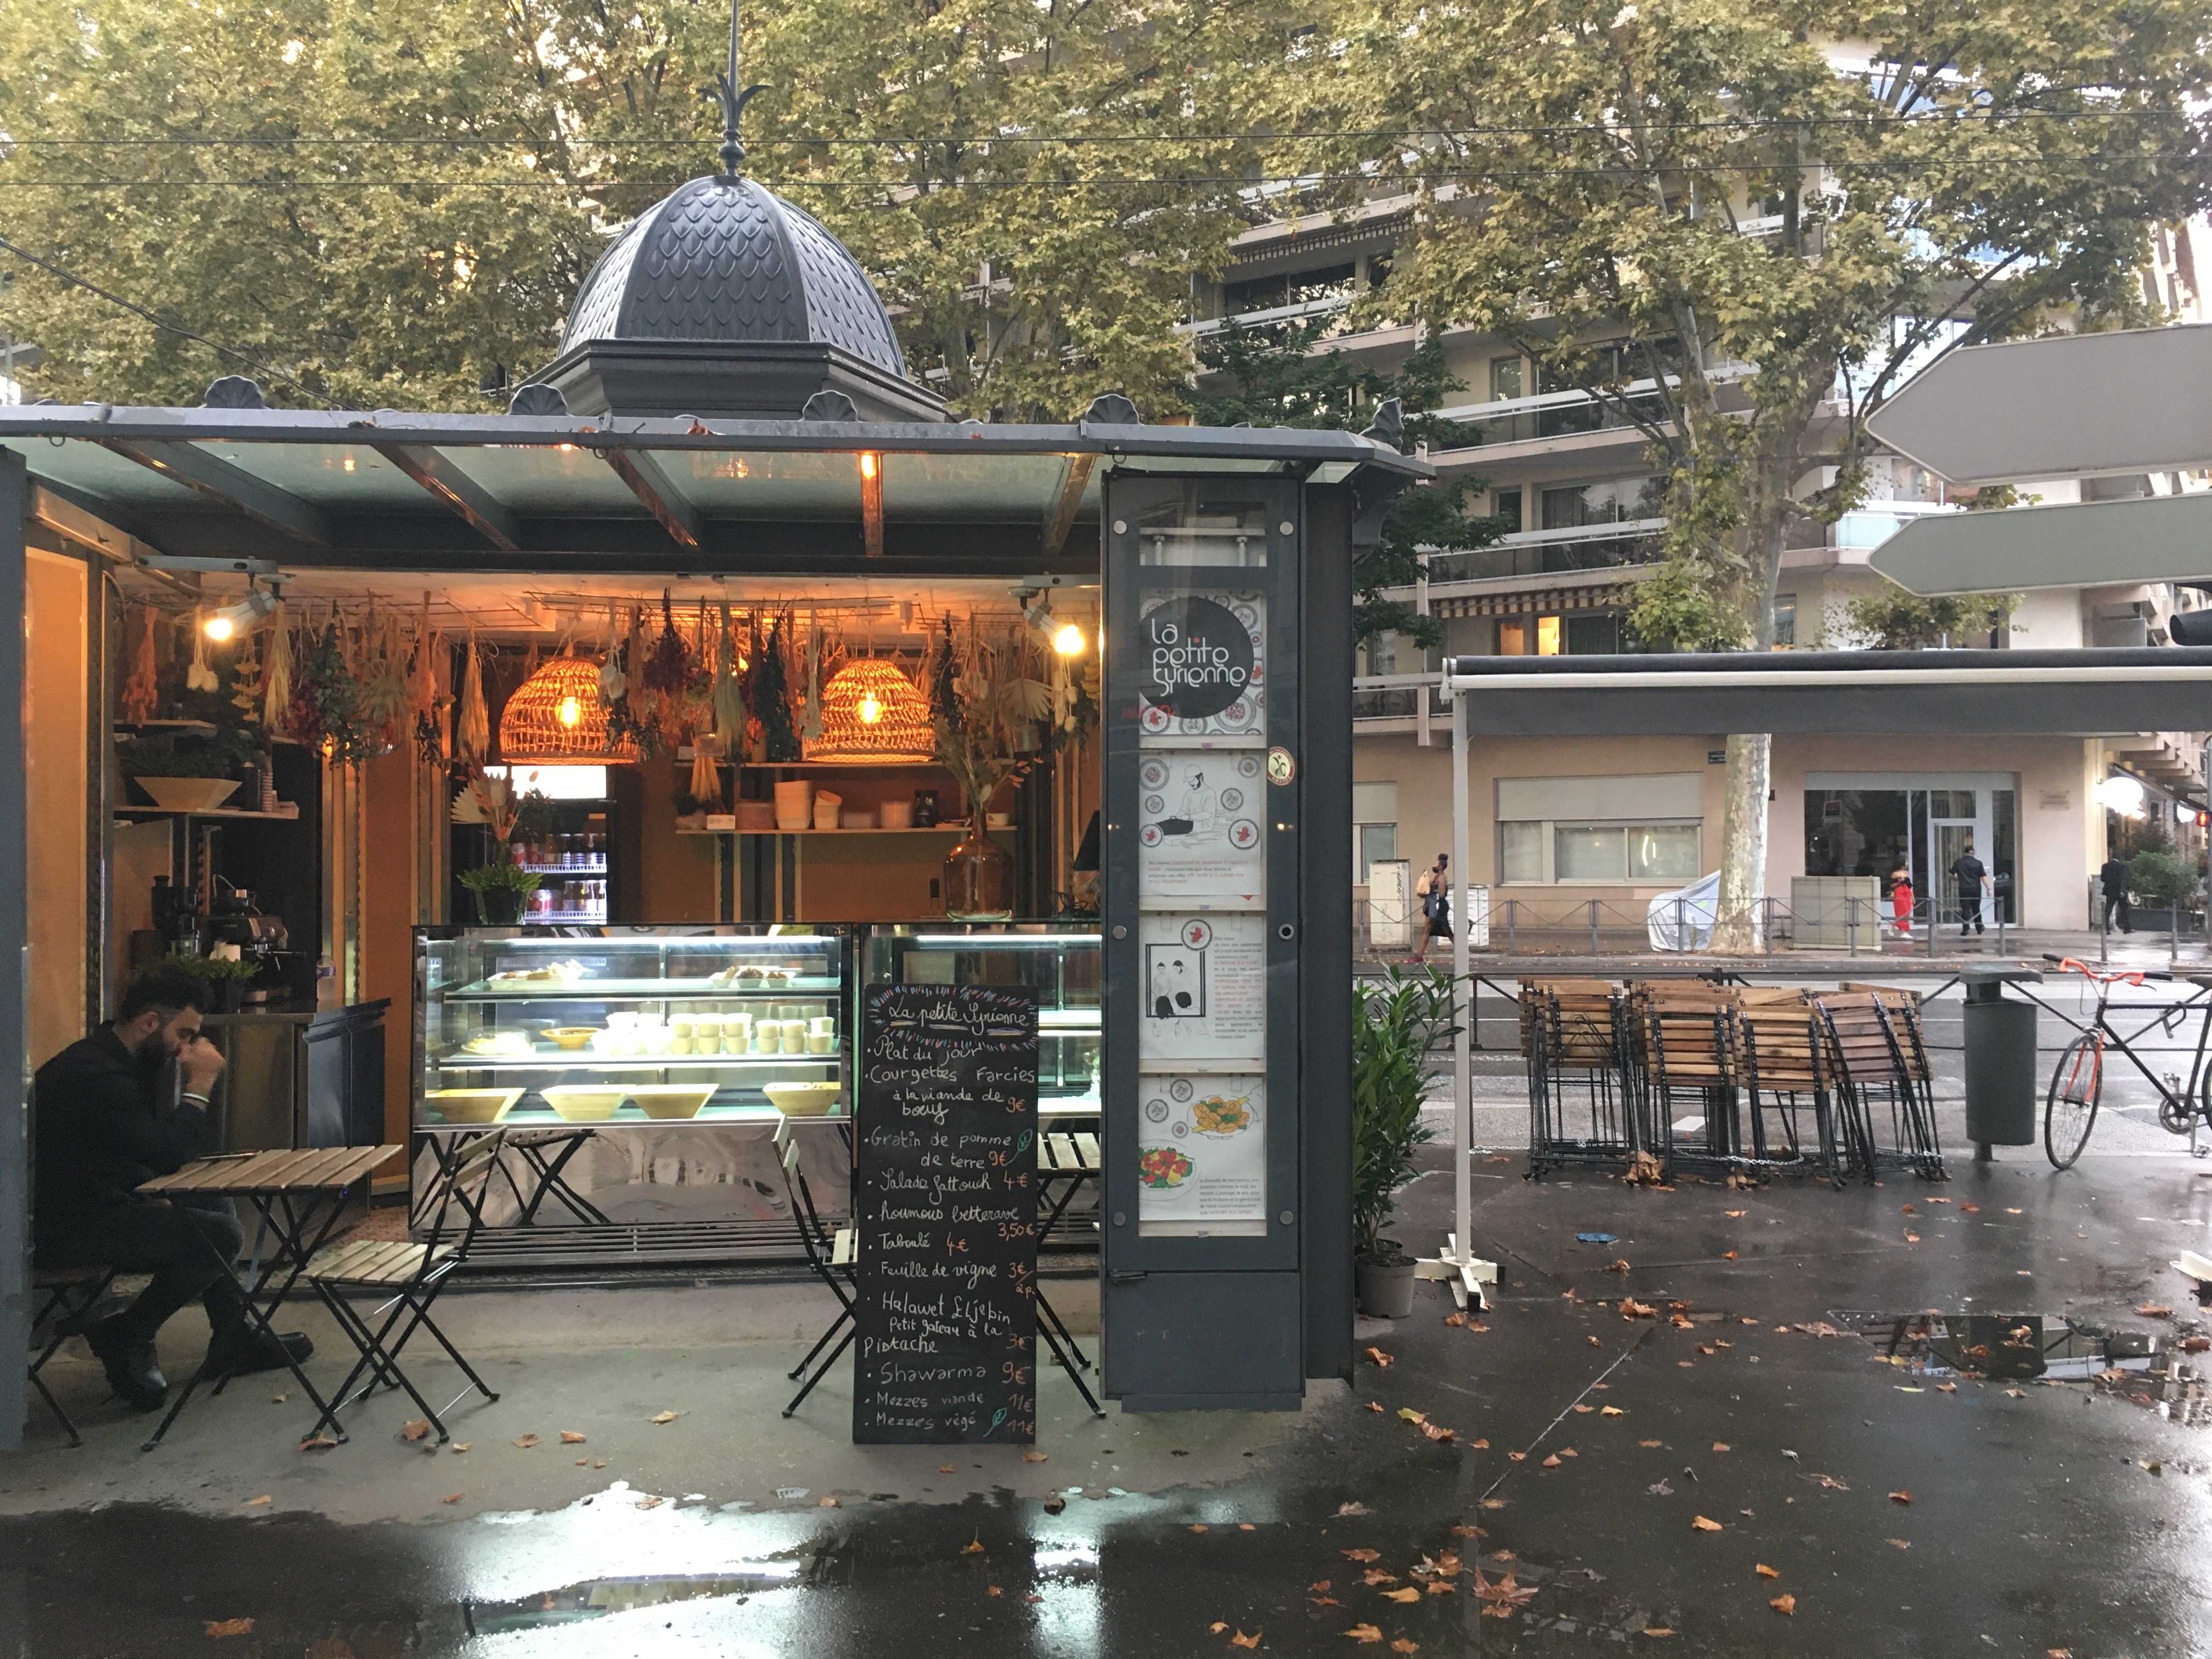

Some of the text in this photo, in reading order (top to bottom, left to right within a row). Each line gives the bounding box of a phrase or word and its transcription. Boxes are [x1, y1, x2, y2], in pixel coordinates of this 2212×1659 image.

[1153, 636, 1229, 668] petite
[1153, 666, 1246, 697] syrienne
[889, 995, 915, 1018] La
[917, 1001, 962, 1028] petite
[873, 1035, 981, 1066] Plat du jour
[870, 1064, 1035, 1084] Courgettes Farcies
[893, 1087, 1026, 1113] à la viande de 9€
[871, 1125, 1012, 1149] Gratin de pomme
[920, 1150, 1008, 1169] de terre 9€
[879, 1167, 929, 1190] Salade
[951, 1205, 1020, 1223] betterave
[878, 1231, 969, 1256] Taboulé 4€
[881, 1261, 928, 1278] Feuille
[932, 1262, 950, 1277] de
[952, 1260, 997, 1289] vigne
[882, 1290, 944, 1316] Halawet
[889, 1316, 917, 1333] Petit
[968, 1323, 978, 1338] à
[984, 1322, 1002, 1336] la
[1005, 1333, 1033, 1351] 3€
[881, 1361, 1031, 1384] Shawarma 9€
[877, 1391, 1034, 1412] Mezzes viande 11€
[876, 1410, 1035, 1436] Mezzes végé 11€
